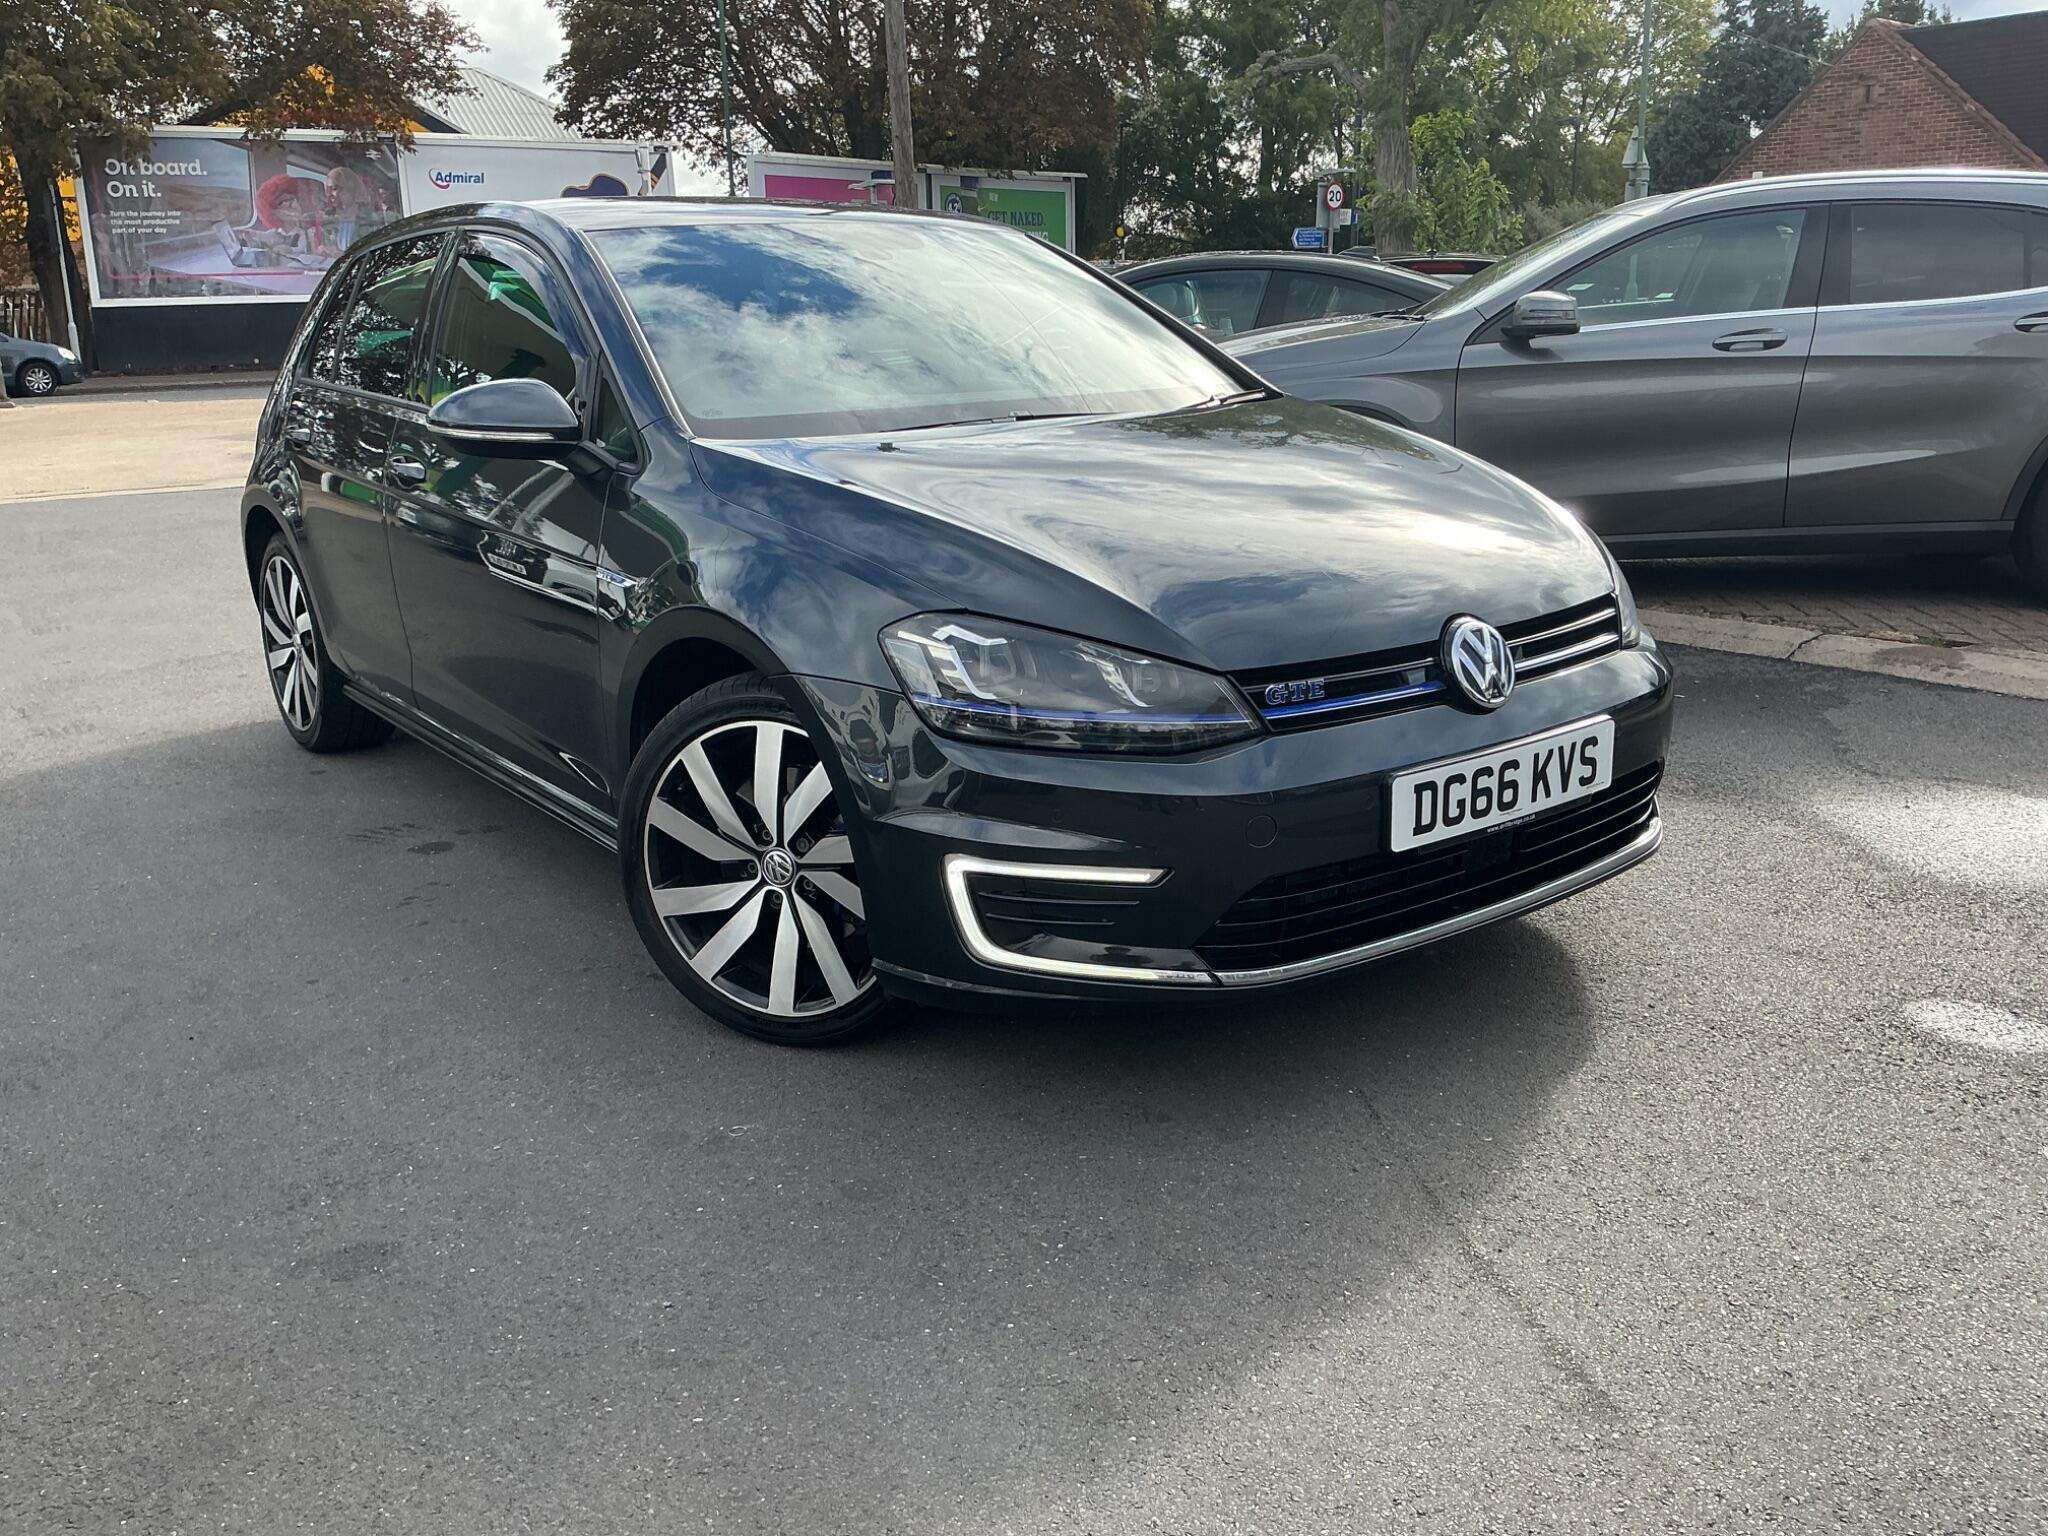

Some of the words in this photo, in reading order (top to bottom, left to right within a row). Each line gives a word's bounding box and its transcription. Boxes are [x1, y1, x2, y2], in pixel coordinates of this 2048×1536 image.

[138, 158, 208, 176] board.
[435, 171, 485, 184] Admiral
[107, 180, 139, 198] On
[141, 180, 162, 198] it.
[1329, 191, 1341, 202] 20
[987, 210, 1008, 224] GET
[1010, 211, 1046, 227] NAKED.
[1265, 679, 1326, 706] GTE
[1411, 758, 1521, 837] DG66
[1529, 735, 1600, 804] KVS
